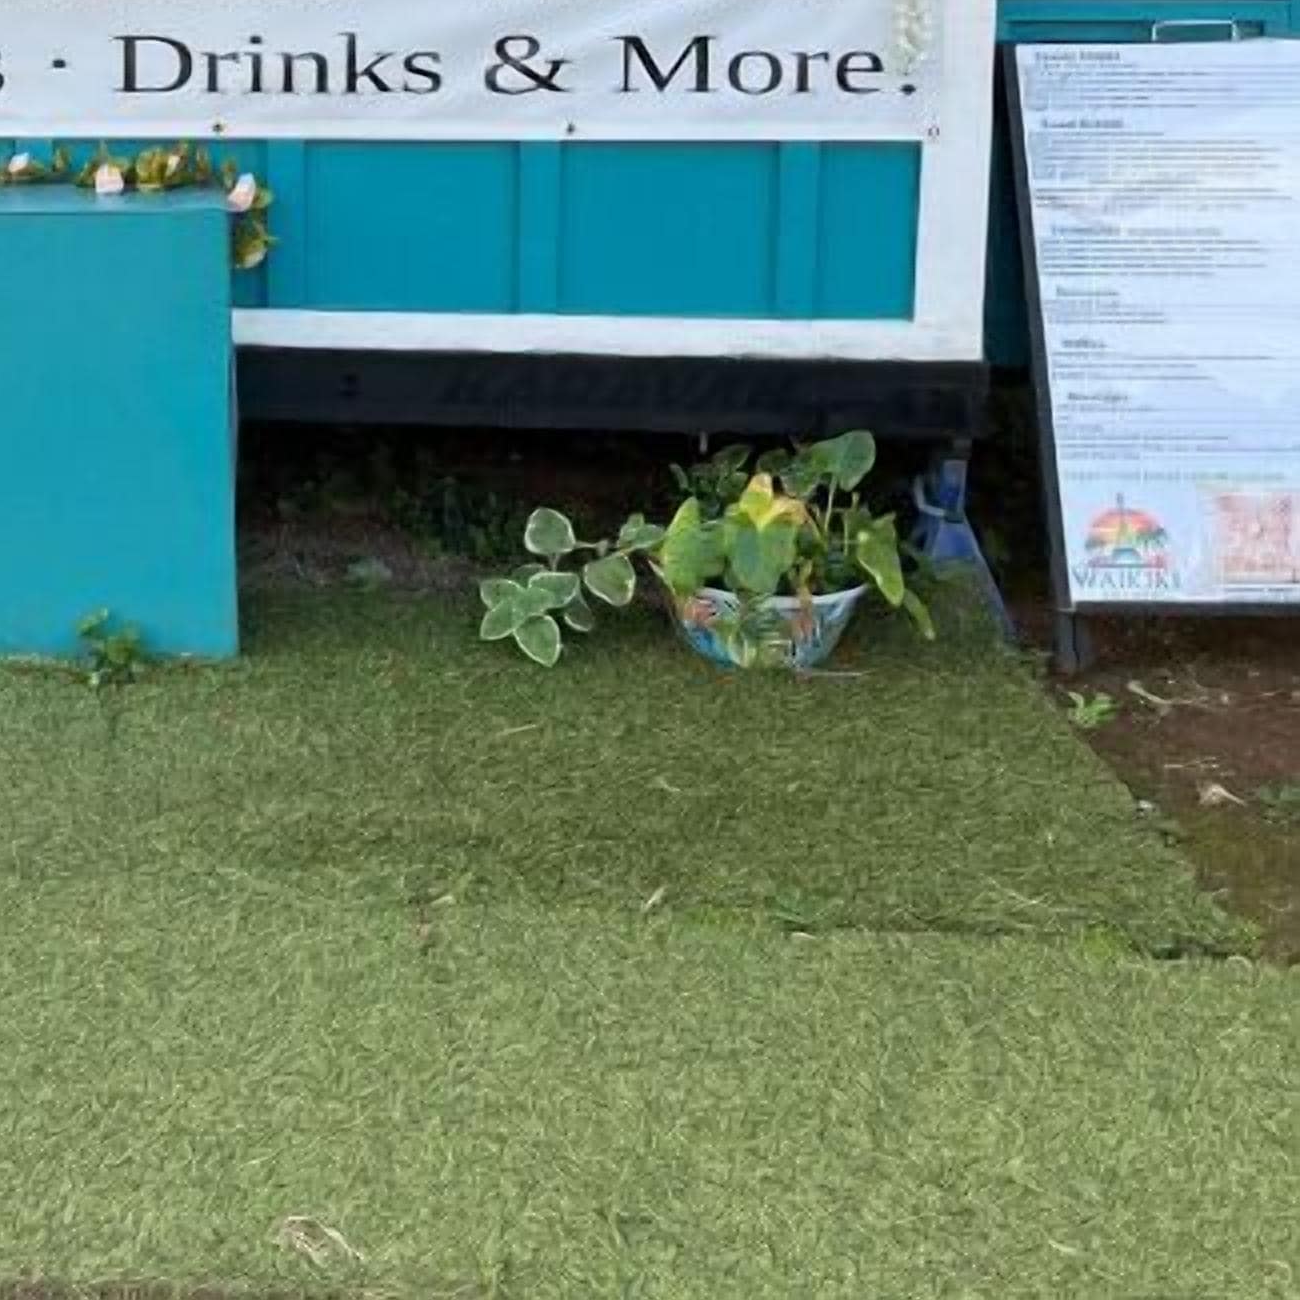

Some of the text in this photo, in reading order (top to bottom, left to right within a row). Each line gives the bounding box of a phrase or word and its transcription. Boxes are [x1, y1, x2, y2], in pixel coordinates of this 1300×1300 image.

[112, 32, 443, 96] Drinks
[483, 34, 573, 97] &
[611, 34, 917, 96] More.
